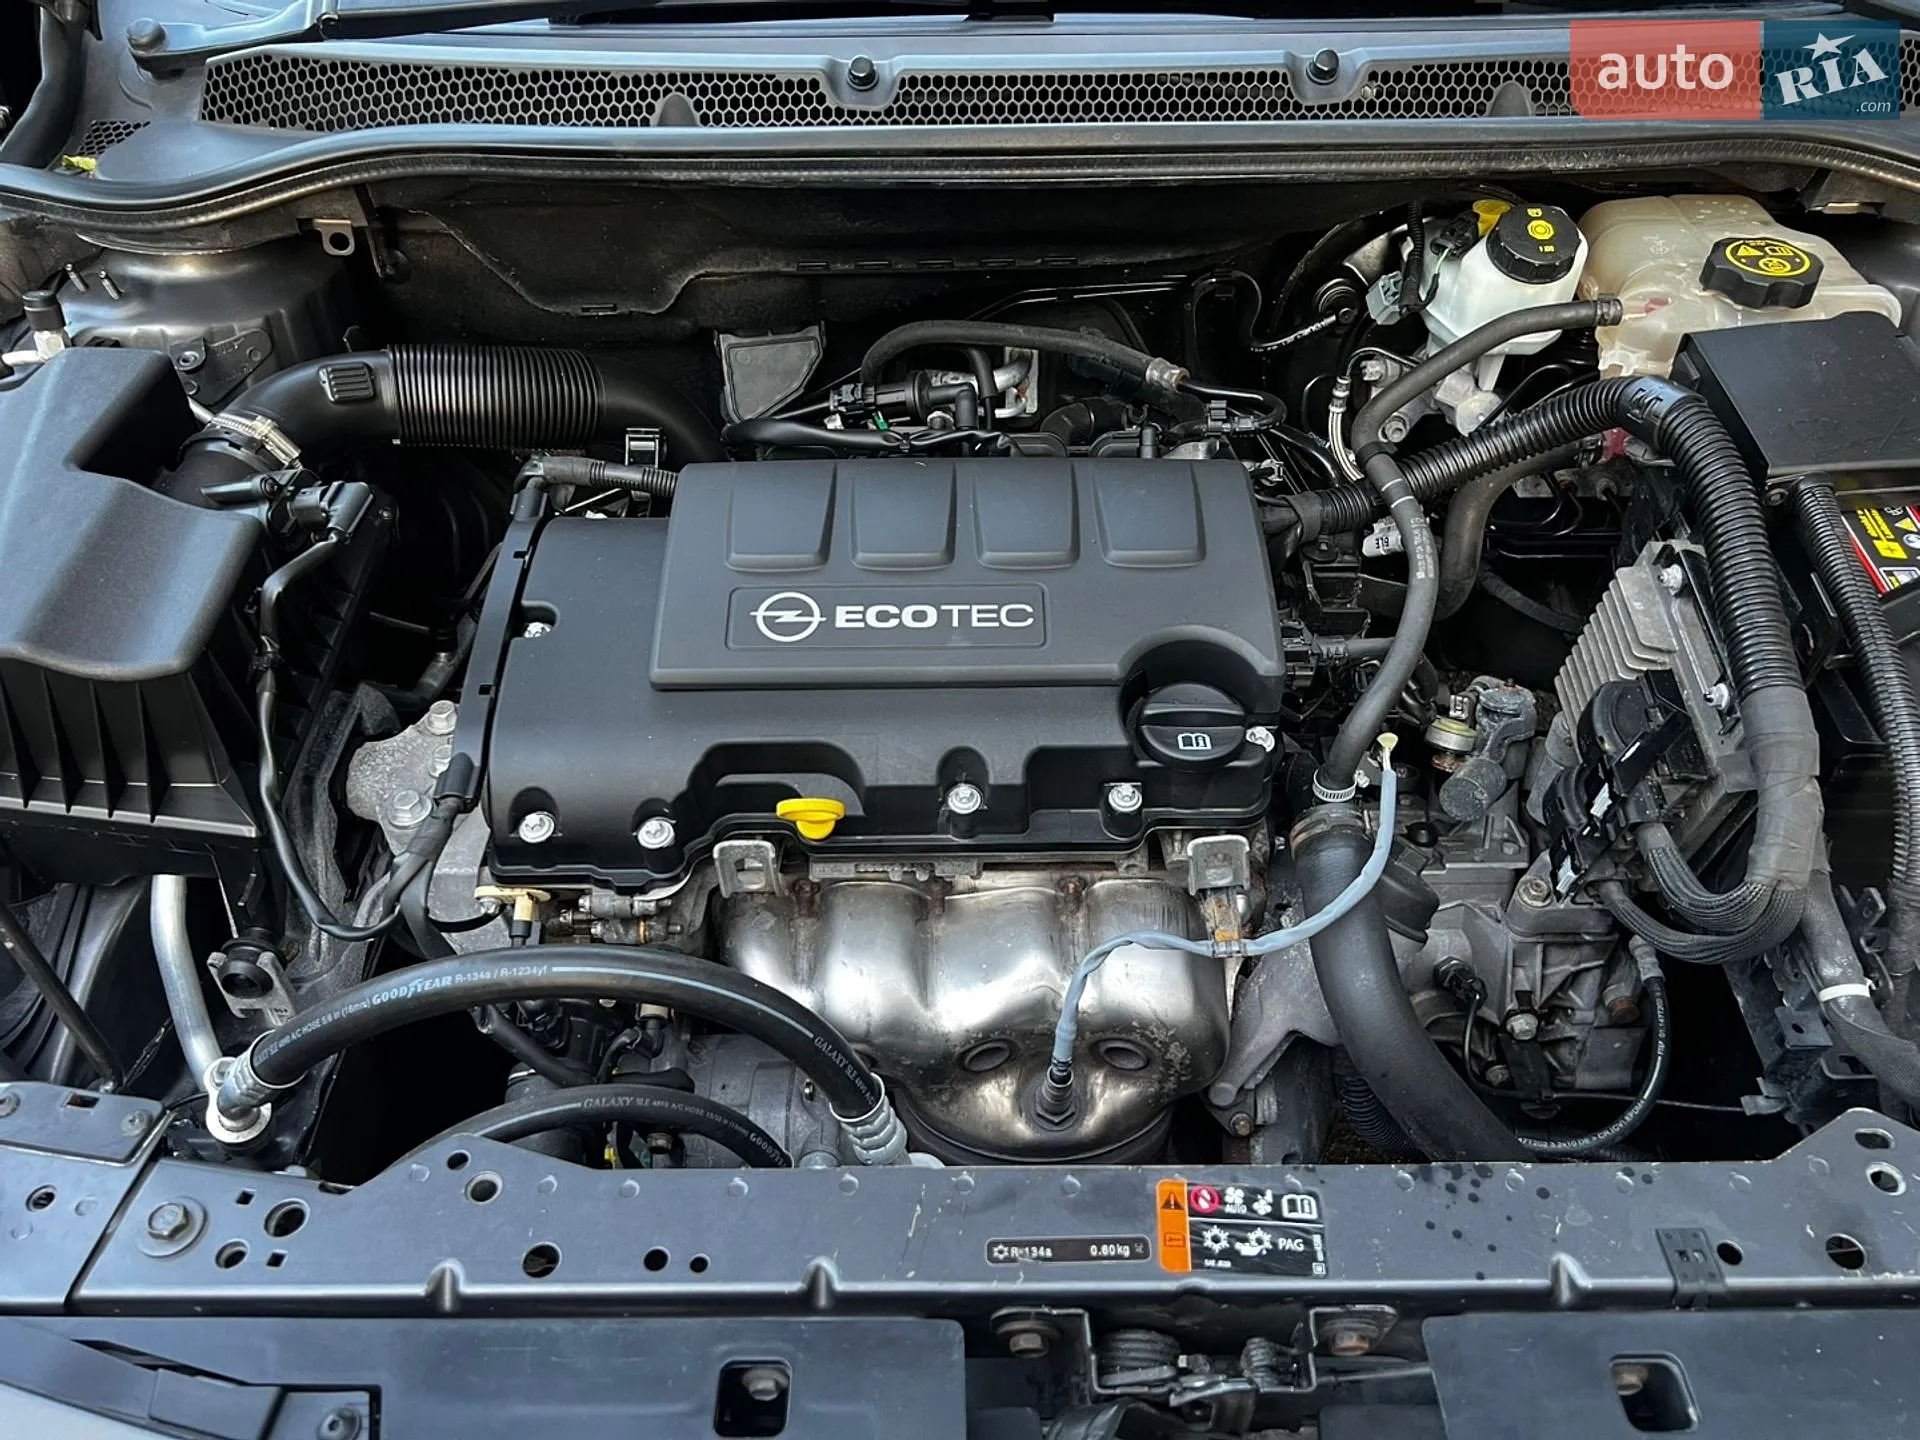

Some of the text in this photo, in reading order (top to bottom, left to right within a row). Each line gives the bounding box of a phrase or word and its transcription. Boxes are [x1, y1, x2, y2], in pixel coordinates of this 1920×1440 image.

[835, 603, 1034, 628] ECOTEC
[372, 975, 452, 1006] GOODYEAR
[455, 970, 492, 984] R-134a
[814, 1037, 849, 1068] GALAXY
[584, 1096, 635, 1110] GALAXY
[1225, 1204, 1248, 1214] AUTO
[1278, 1237, 1305, 1252] PAG
[1010, 1246, 1053, 1259] R-134a
